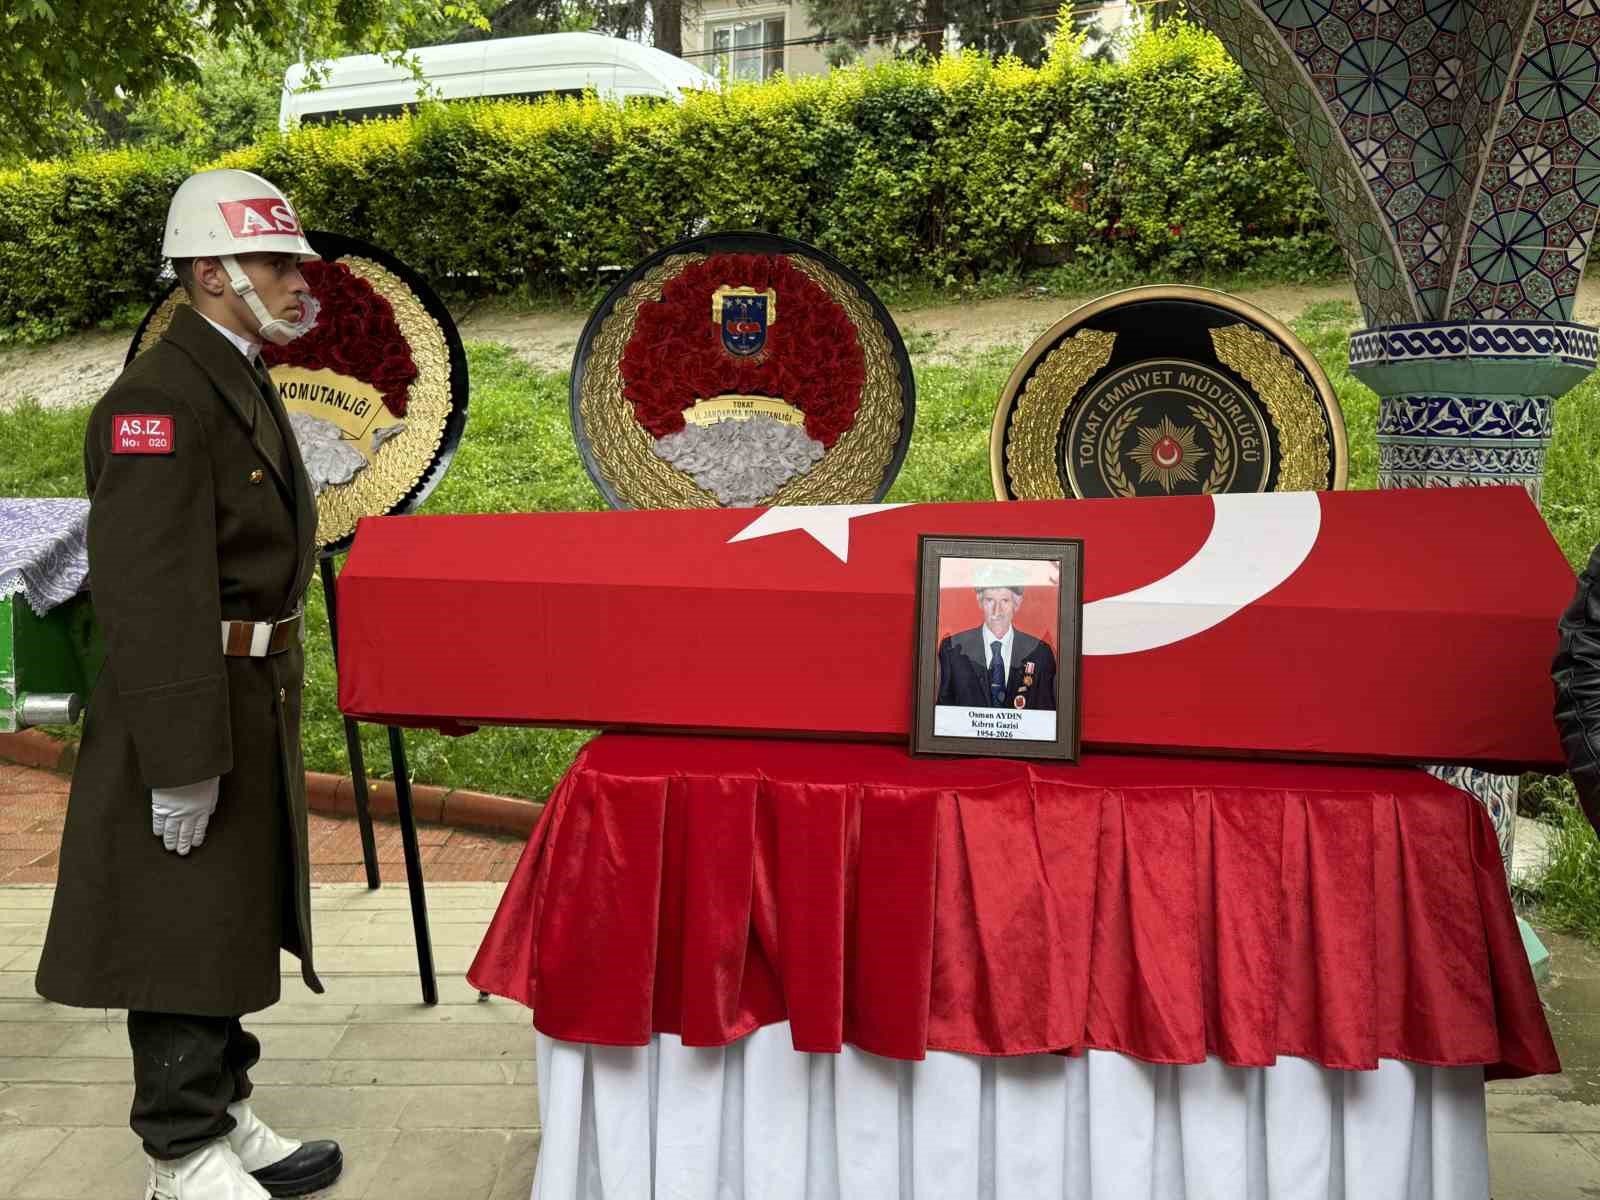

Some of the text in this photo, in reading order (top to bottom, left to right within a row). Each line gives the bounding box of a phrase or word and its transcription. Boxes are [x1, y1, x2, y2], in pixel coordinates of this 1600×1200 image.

[240, 205, 298, 233] AS
[280, 382, 371, 418] KOMUTANLIĞI
[733, 401, 754, 409] TOKAT
[1080, 371, 1260, 468] TOKAT EMNİYET MÜDÜRLÜĞÜ
[148, 438, 167, 448] 020
[968, 711, 1023, 720] Osman AYDIN
[996, 721, 1019, 729] Gazisi
[976, 730, 1013, 738] 1954-2026
